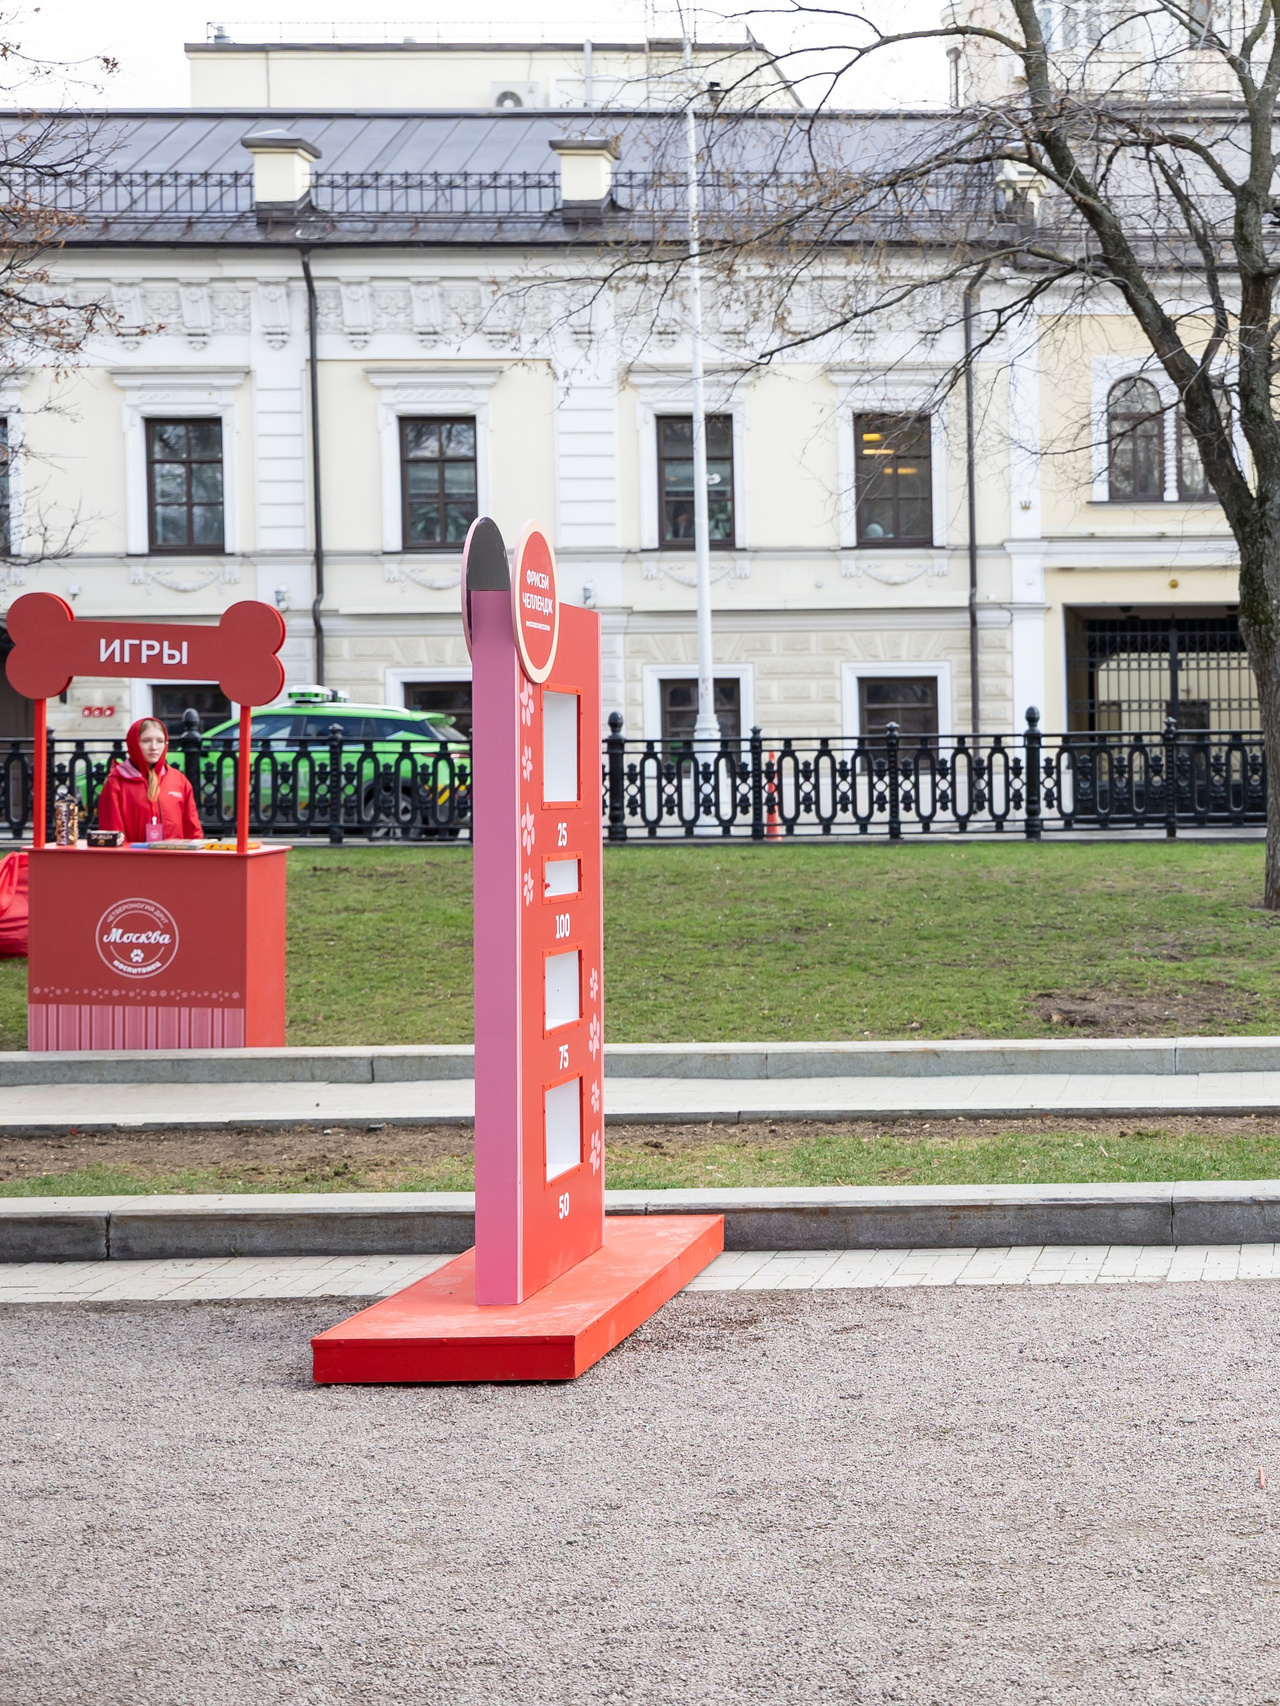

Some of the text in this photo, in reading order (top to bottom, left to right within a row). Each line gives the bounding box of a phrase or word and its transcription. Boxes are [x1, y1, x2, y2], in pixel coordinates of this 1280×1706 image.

[526, 569, 549, 590] ФРИСБИ
[522, 592, 554, 616] ЧЕЛЛЕНДЖ
[99, 638, 188, 665] ИГРЫ
[557, 822, 568, 847] 25
[103, 928, 171, 944] Москва
[555, 912, 571, 939] 100
[558, 1043, 569, 1070] 75
[558, 1191, 570, 1220] 50
